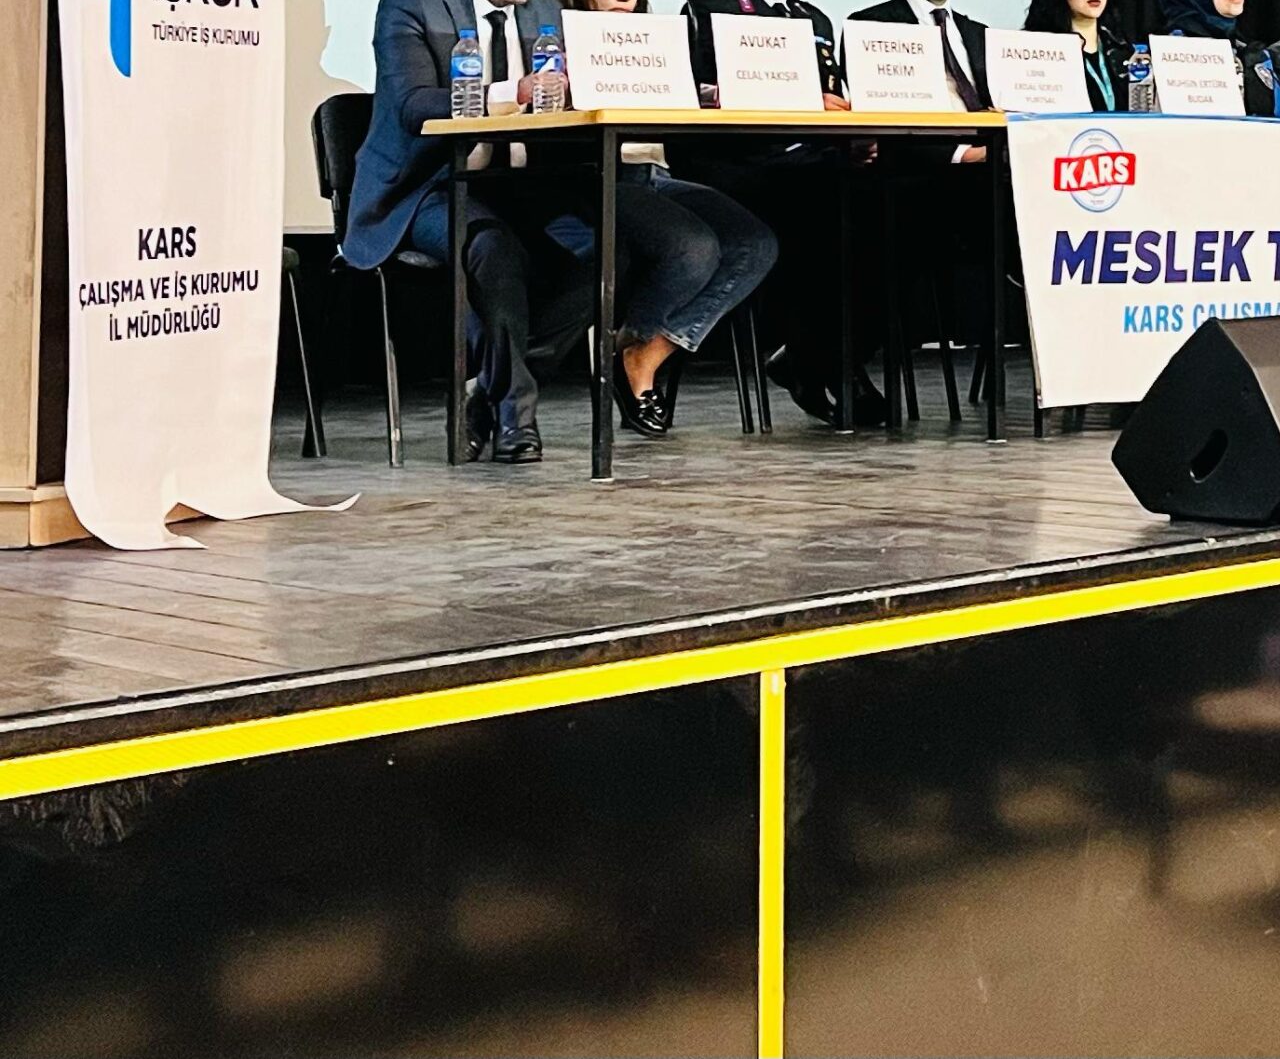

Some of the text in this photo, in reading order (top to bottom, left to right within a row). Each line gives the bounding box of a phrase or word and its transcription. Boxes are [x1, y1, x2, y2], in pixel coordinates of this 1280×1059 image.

[152, 20, 260, 47] TÜRKİYE İŞ KURUMU
[602, 29, 650, 46] İNŞAAT
[740, 35, 787, 49] AVUKAT
[862, 39, 925, 54] VETERİNER
[590, 52, 667, 68] MÜHENDİSİ
[1001, 47, 1067, 62] JANDARMA
[1060, 155, 1129, 189] KARS
[138, 225, 196, 261] KARS
[1051, 230, 1255, 285] MESLEK
[79, 269, 259, 310] ÇALIŞMA VE İŞ KURUMU
[109, 302, 221, 341] İL MÜDÜRLÜĞÜ
[1124, 303, 1184, 333] KARS
